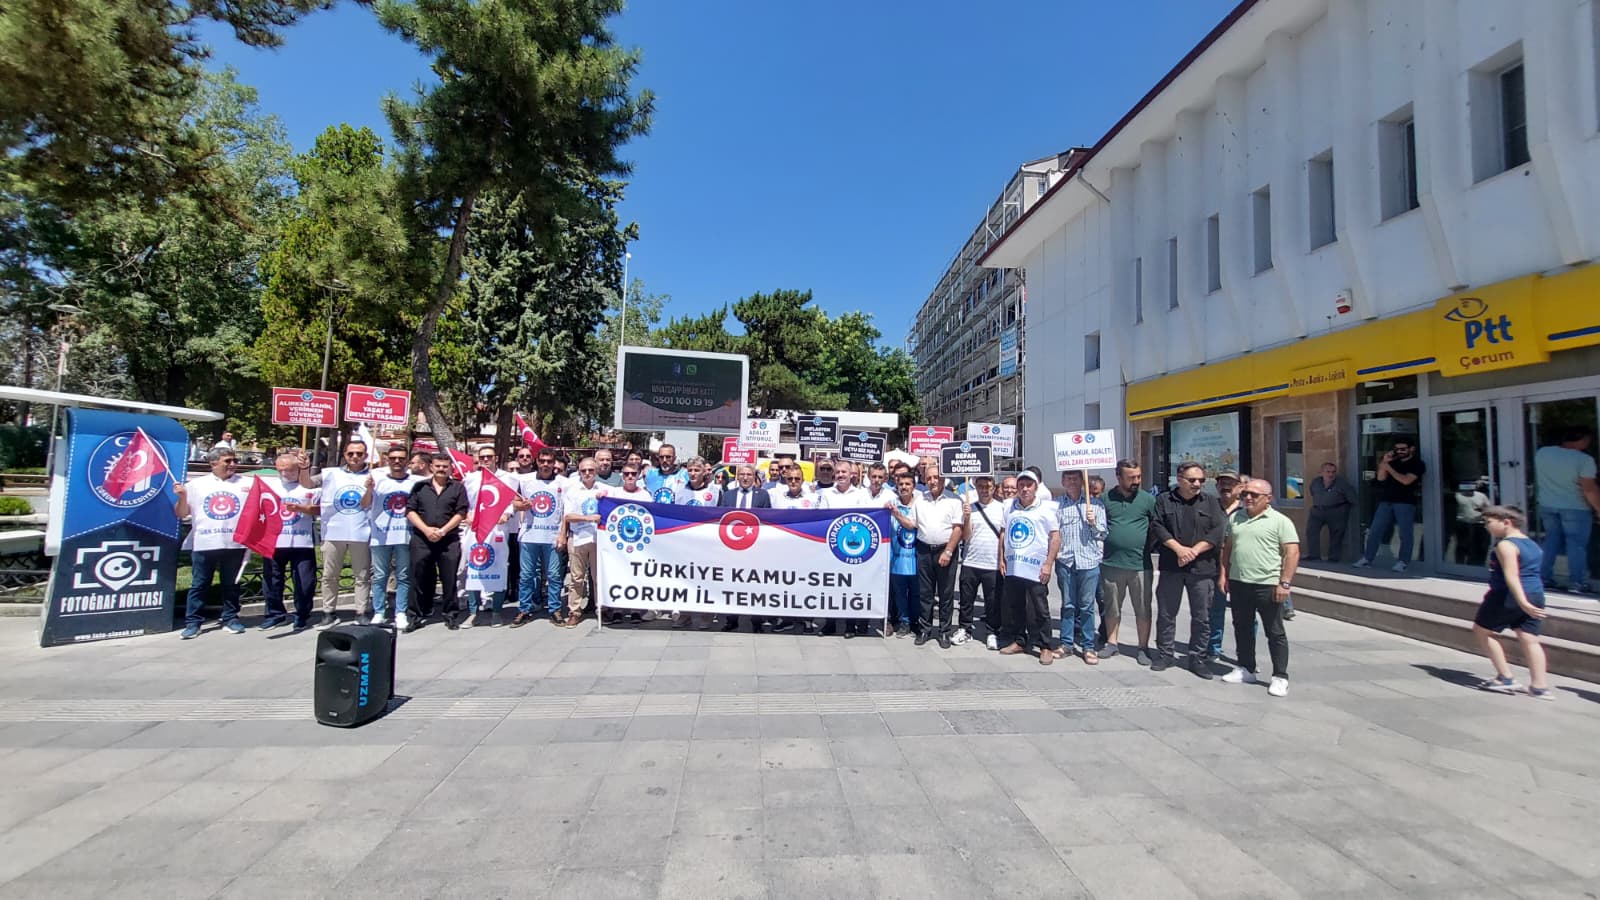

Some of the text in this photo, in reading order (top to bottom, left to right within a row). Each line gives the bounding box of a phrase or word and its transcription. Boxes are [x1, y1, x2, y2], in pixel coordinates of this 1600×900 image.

[1465, 315, 1514, 348] Ptt
[1460, 351, 1514, 369] Çorum
[653, 396, 713, 407] 0501 100 19 19
[830, 516, 879, 549] TÜRKİYE KAMU-SEN
[630, 559, 852, 587] TÜRKİYE KAMU-SEN
[60, 590, 163, 613] FOTOĞRAF NOKTASI
[609, 584, 872, 611] ÇORUM İL TEMSİLCİLİĞİ
[359, 653, 370, 706] UZMAN
